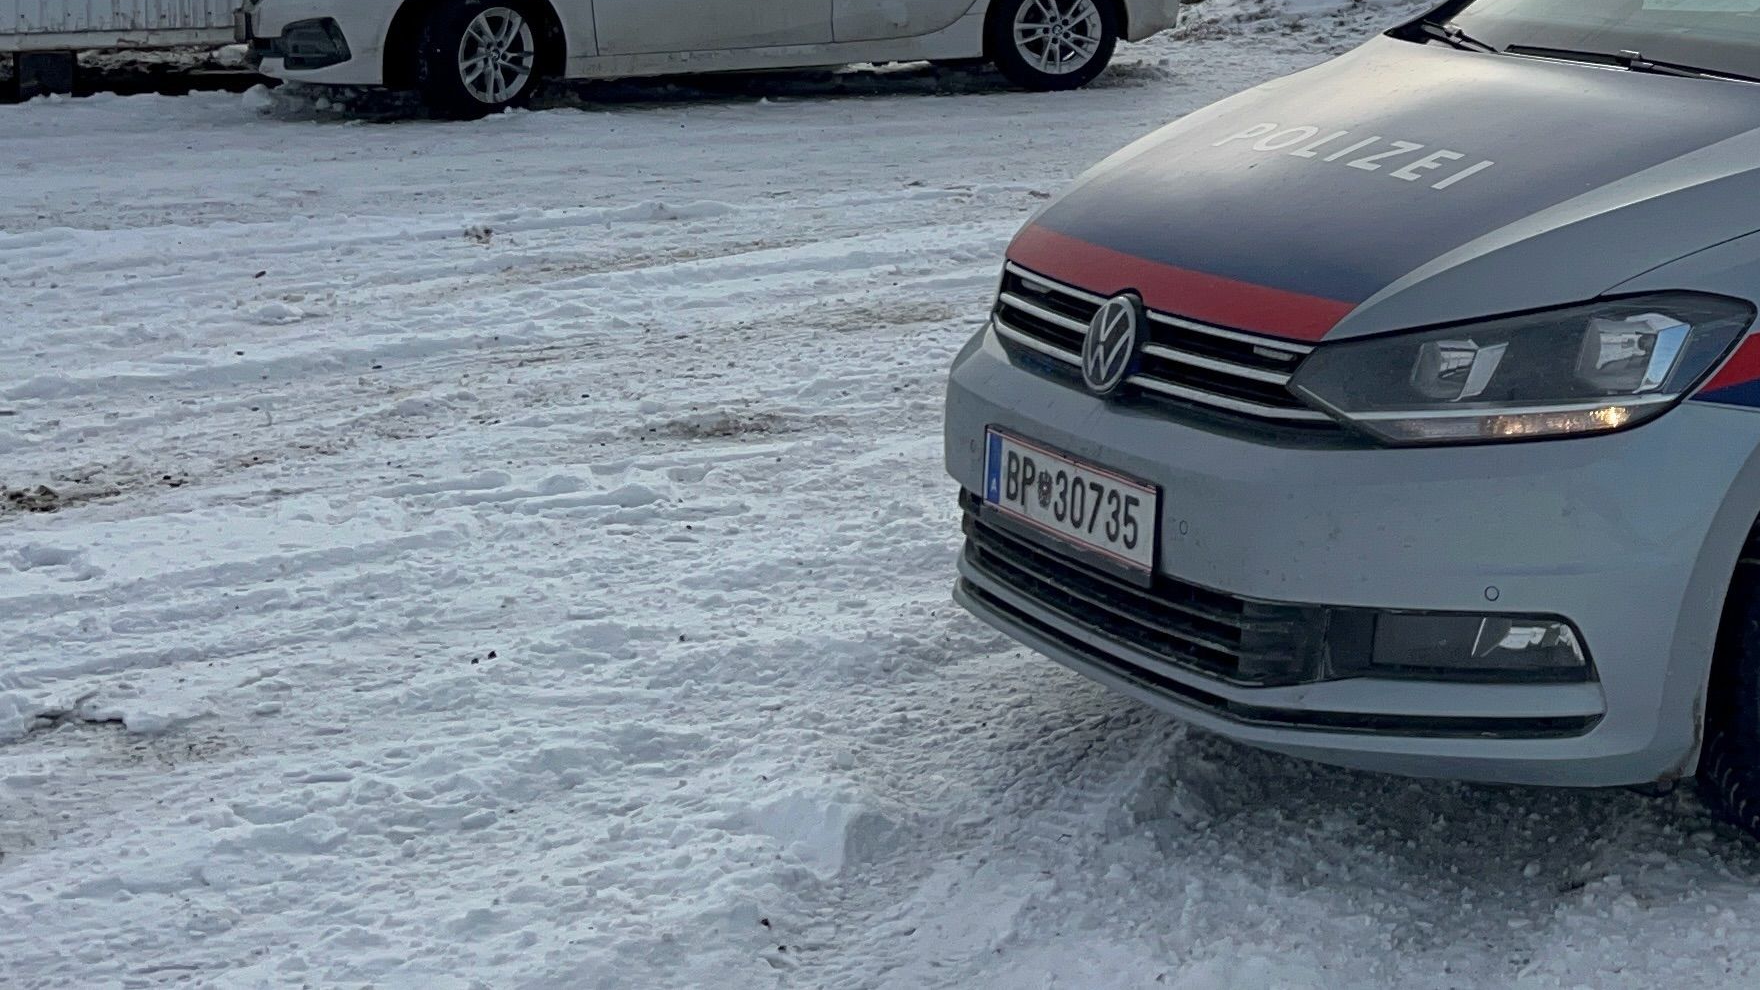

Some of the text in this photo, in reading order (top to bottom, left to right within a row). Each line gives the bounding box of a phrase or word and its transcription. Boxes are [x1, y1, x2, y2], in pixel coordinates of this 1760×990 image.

[1211, 121, 1496, 191] POLIZEI
[1005, 449, 1140, 550] BP 30735
